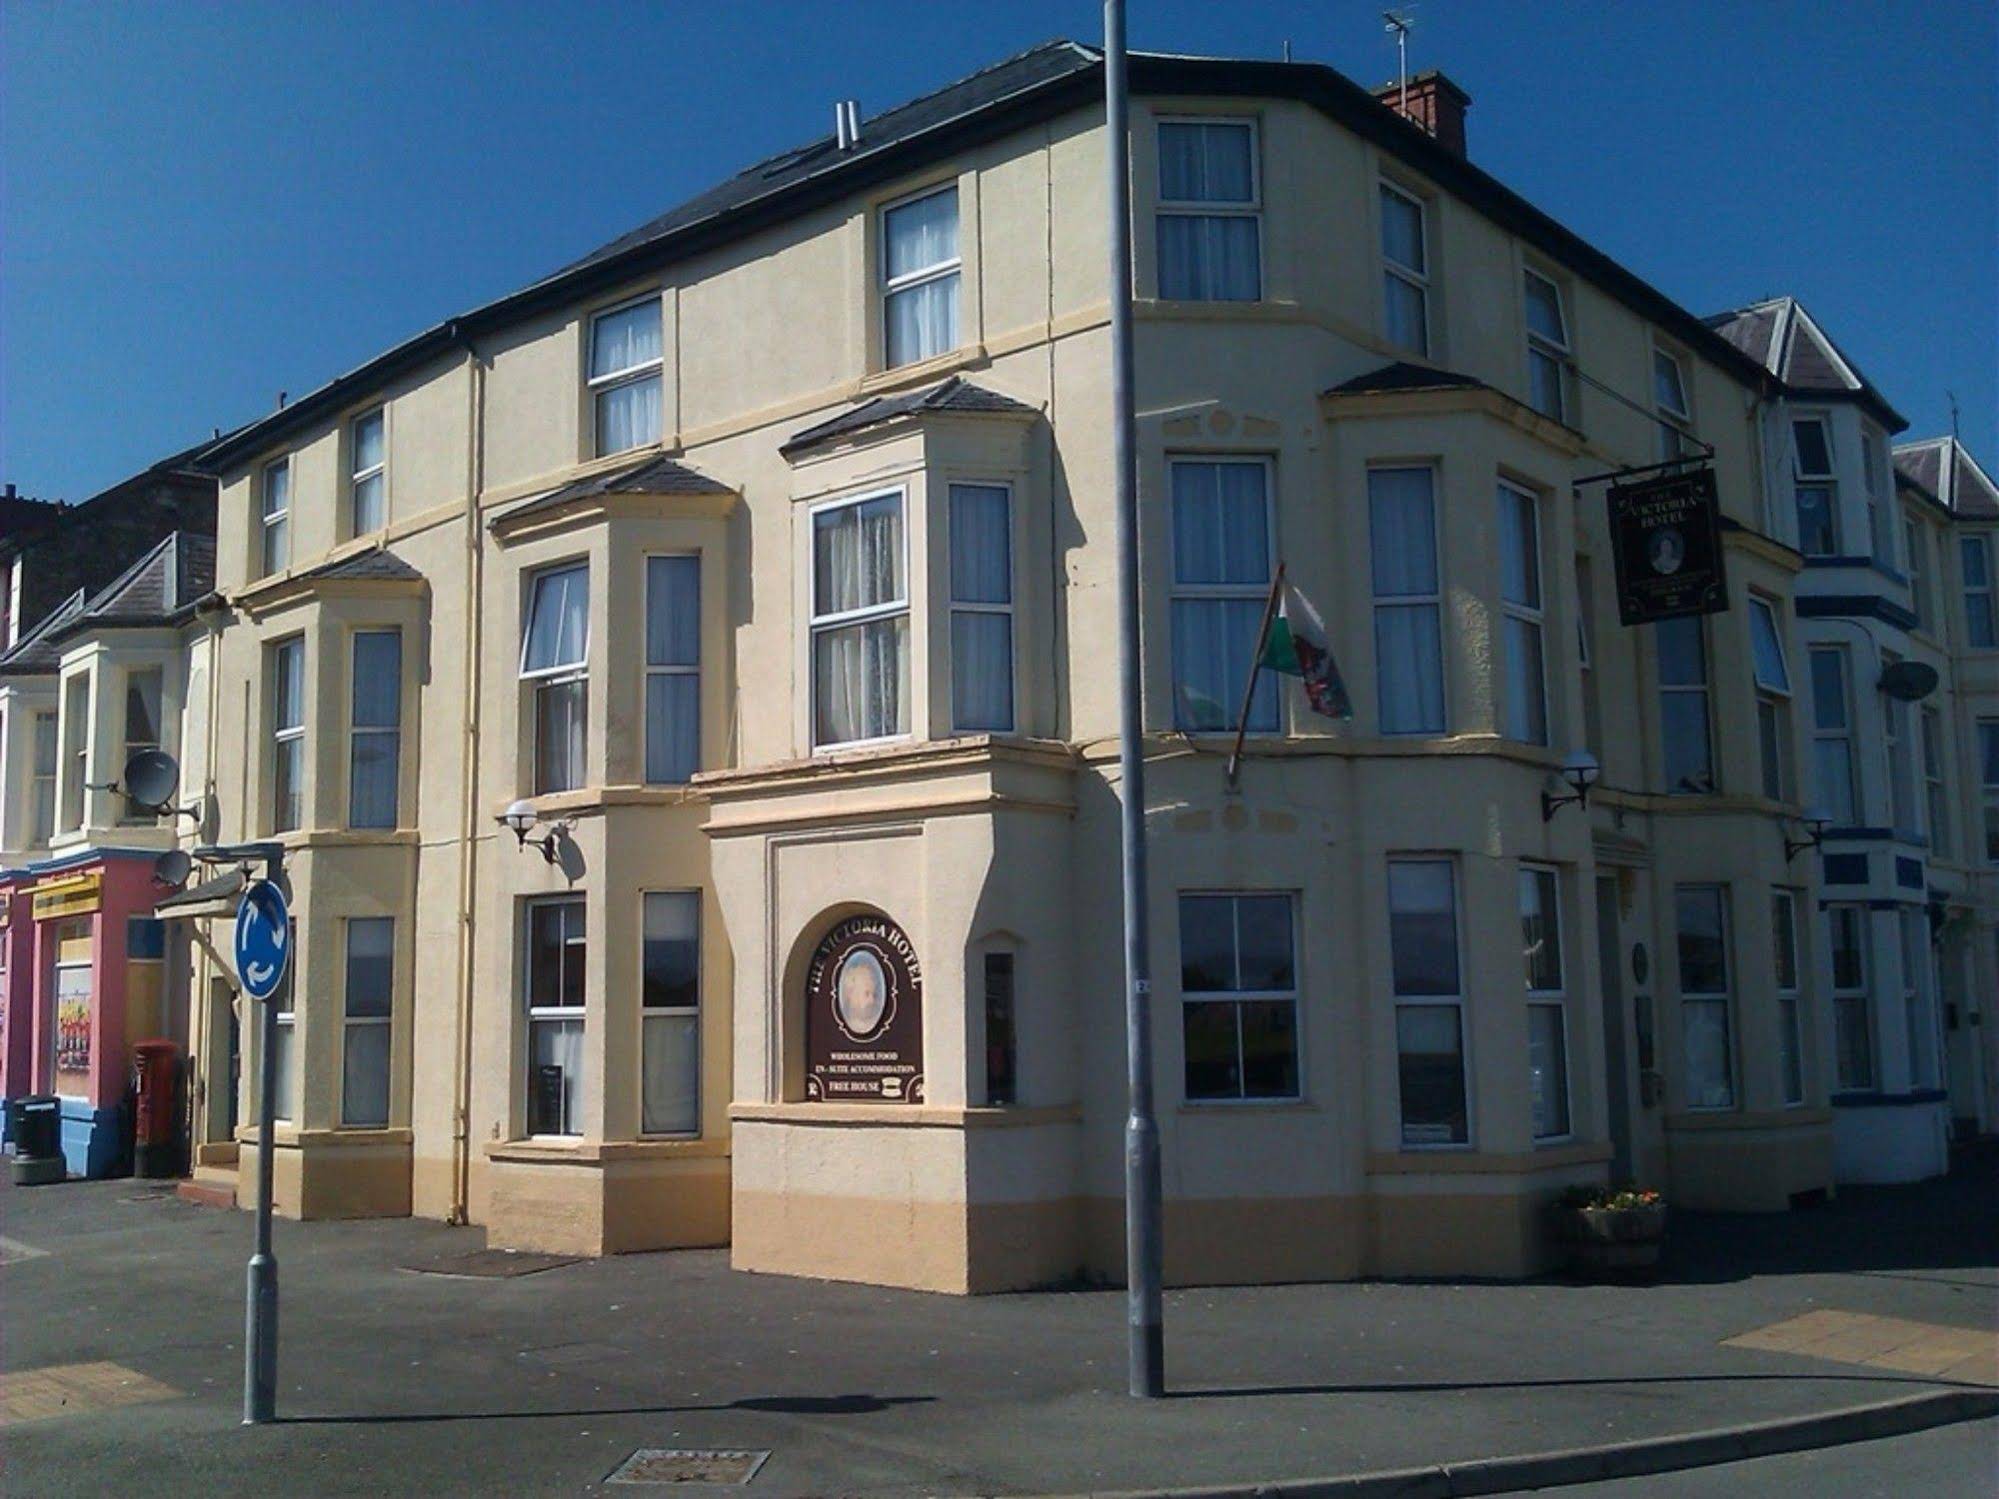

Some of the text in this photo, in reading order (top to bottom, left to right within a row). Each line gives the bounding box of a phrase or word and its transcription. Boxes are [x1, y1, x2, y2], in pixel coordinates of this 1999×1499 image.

[1641, 511, 1687, 528] HOTEL
[821, 919, 886, 953] VICTORIA
[887, 929, 922, 990] HOTEL
[830, 1052, 898, 1061] WHOLESOME FOOD
[850, 1065, 915, 1074] ACCOMMODATION
[828, 1081, 880, 1092] FREE HOUSE
